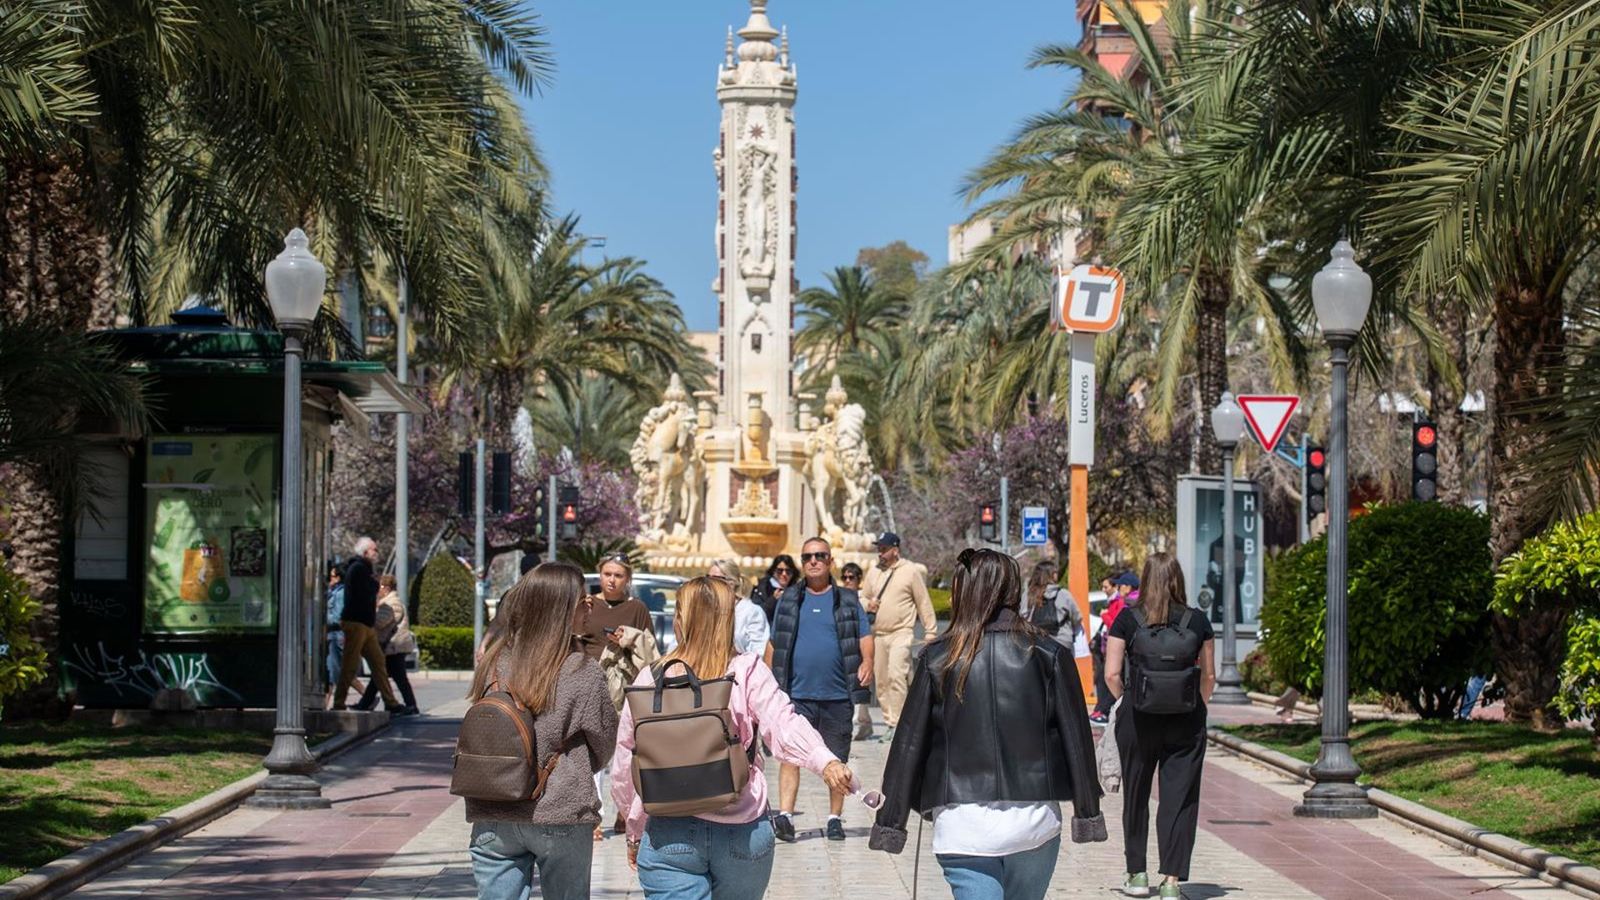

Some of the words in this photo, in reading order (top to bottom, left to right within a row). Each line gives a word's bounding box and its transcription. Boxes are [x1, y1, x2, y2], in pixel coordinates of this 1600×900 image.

[1079, 281, 1111, 317] T
[1078, 374, 1089, 424] Luceros
[1242, 495, 1256, 620] HUBLOT
